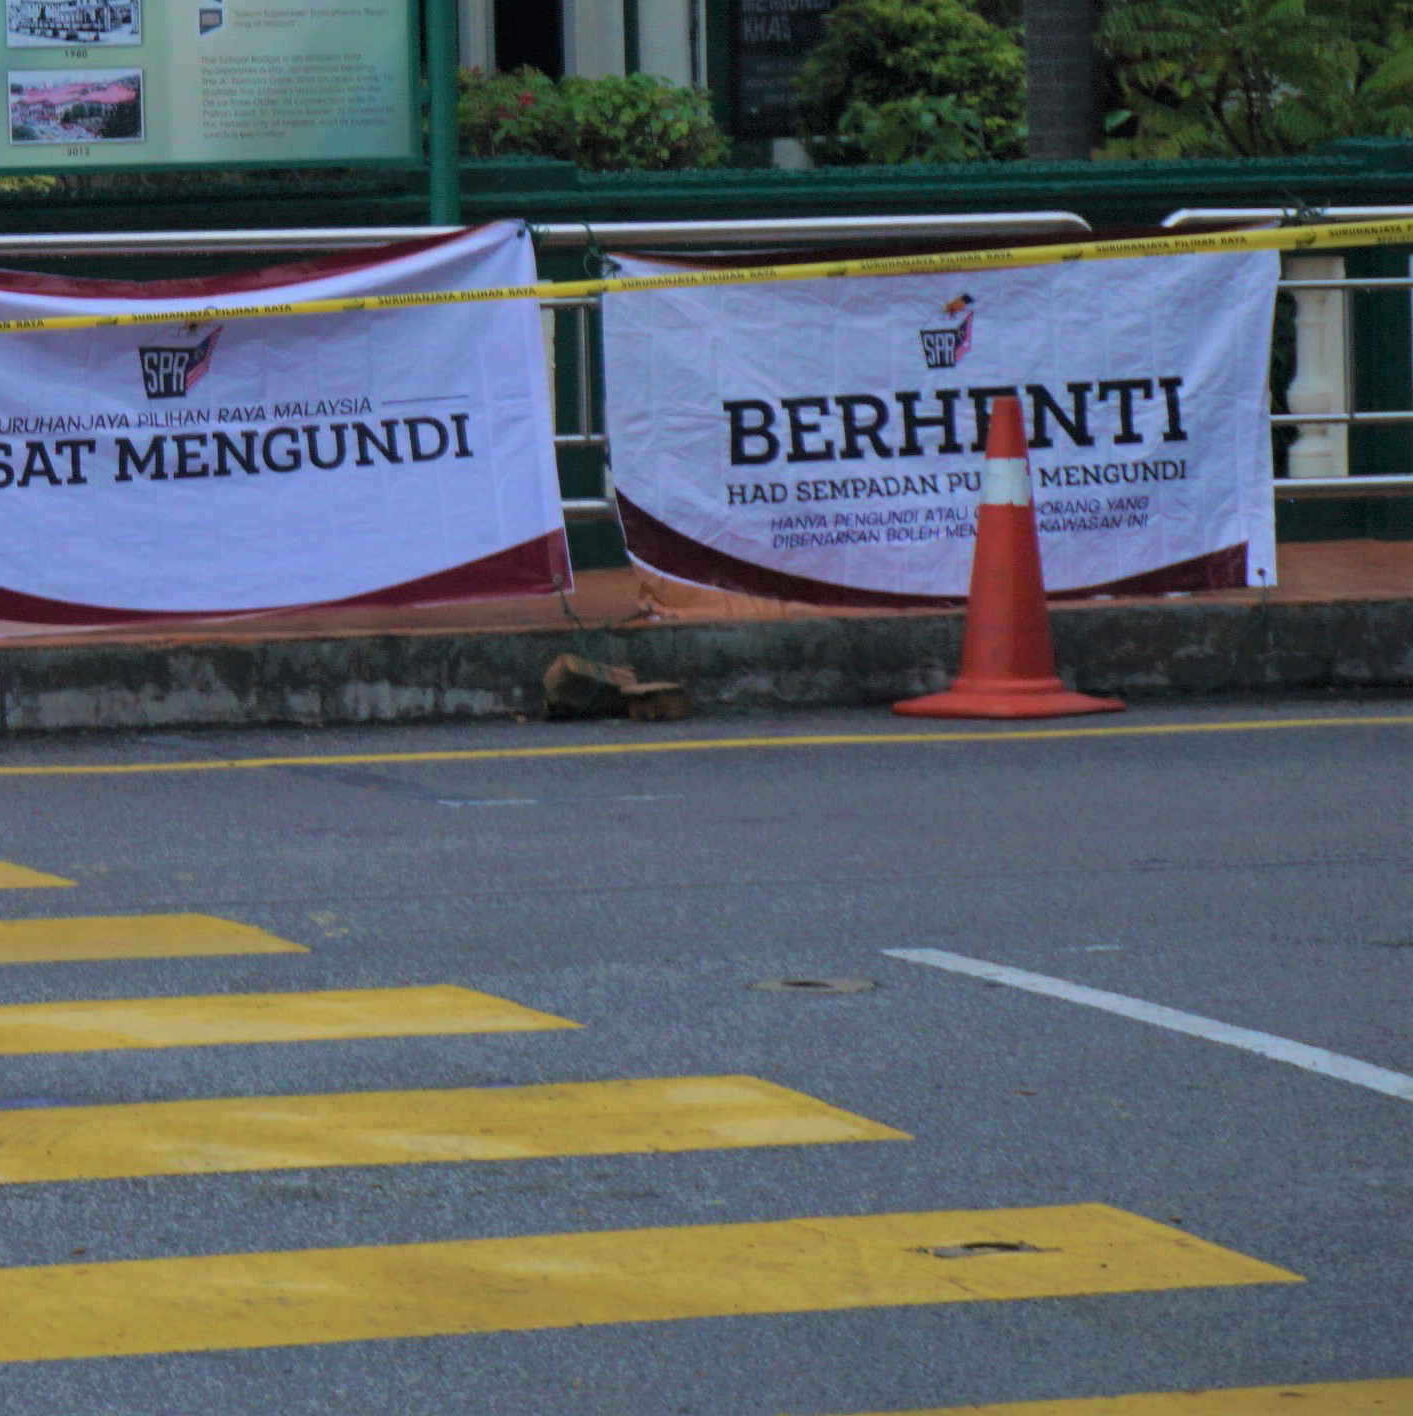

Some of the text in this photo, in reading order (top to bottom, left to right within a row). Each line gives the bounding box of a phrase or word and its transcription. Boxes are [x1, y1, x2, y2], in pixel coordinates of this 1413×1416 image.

[742, 15, 791, 42] KHAS
[1095, 236, 1248, 254] SURUHANJAYA PILIHAN RAYA
[860, 255, 936, 271] SURUHANJAYA
[940, 252, 983, 265] PILIHAN
[986, 250, 1014, 261] RAYA
[621, 269, 778, 290] SURUHANJAYA PILIHAN RAYA
[377, 286, 538, 306] SURUHANJAYA PILIHAN RAYA
[16, 318, 46, 329] RAYA
[132, 304, 293, 322] SURUHANJAYA PILIHAN RAYA
[924, 333, 956, 365] SPR
[142, 350, 190, 397] SPR
[137, 409, 211, 430] PILIHAN
[218, 406, 267, 425] RAYA
[273, 396, 373, 422] MALAYSIA
[114, 412, 475, 482] MENGUNDI
[727, 482, 789, 506] HAD
[795, 474, 940, 503] SEMPADAN
[1038, 460, 1188, 488] MENGUNDI
[771, 496, 1150, 531] HANYA PENGUNDI ATAU YANG
[773, 530, 881, 550] DIBENARKAN
[886, 526, 940, 543] BOLEH
[1039, 515, 1121, 533] KAWASAN
[1126, 514, 1150, 528] INI
